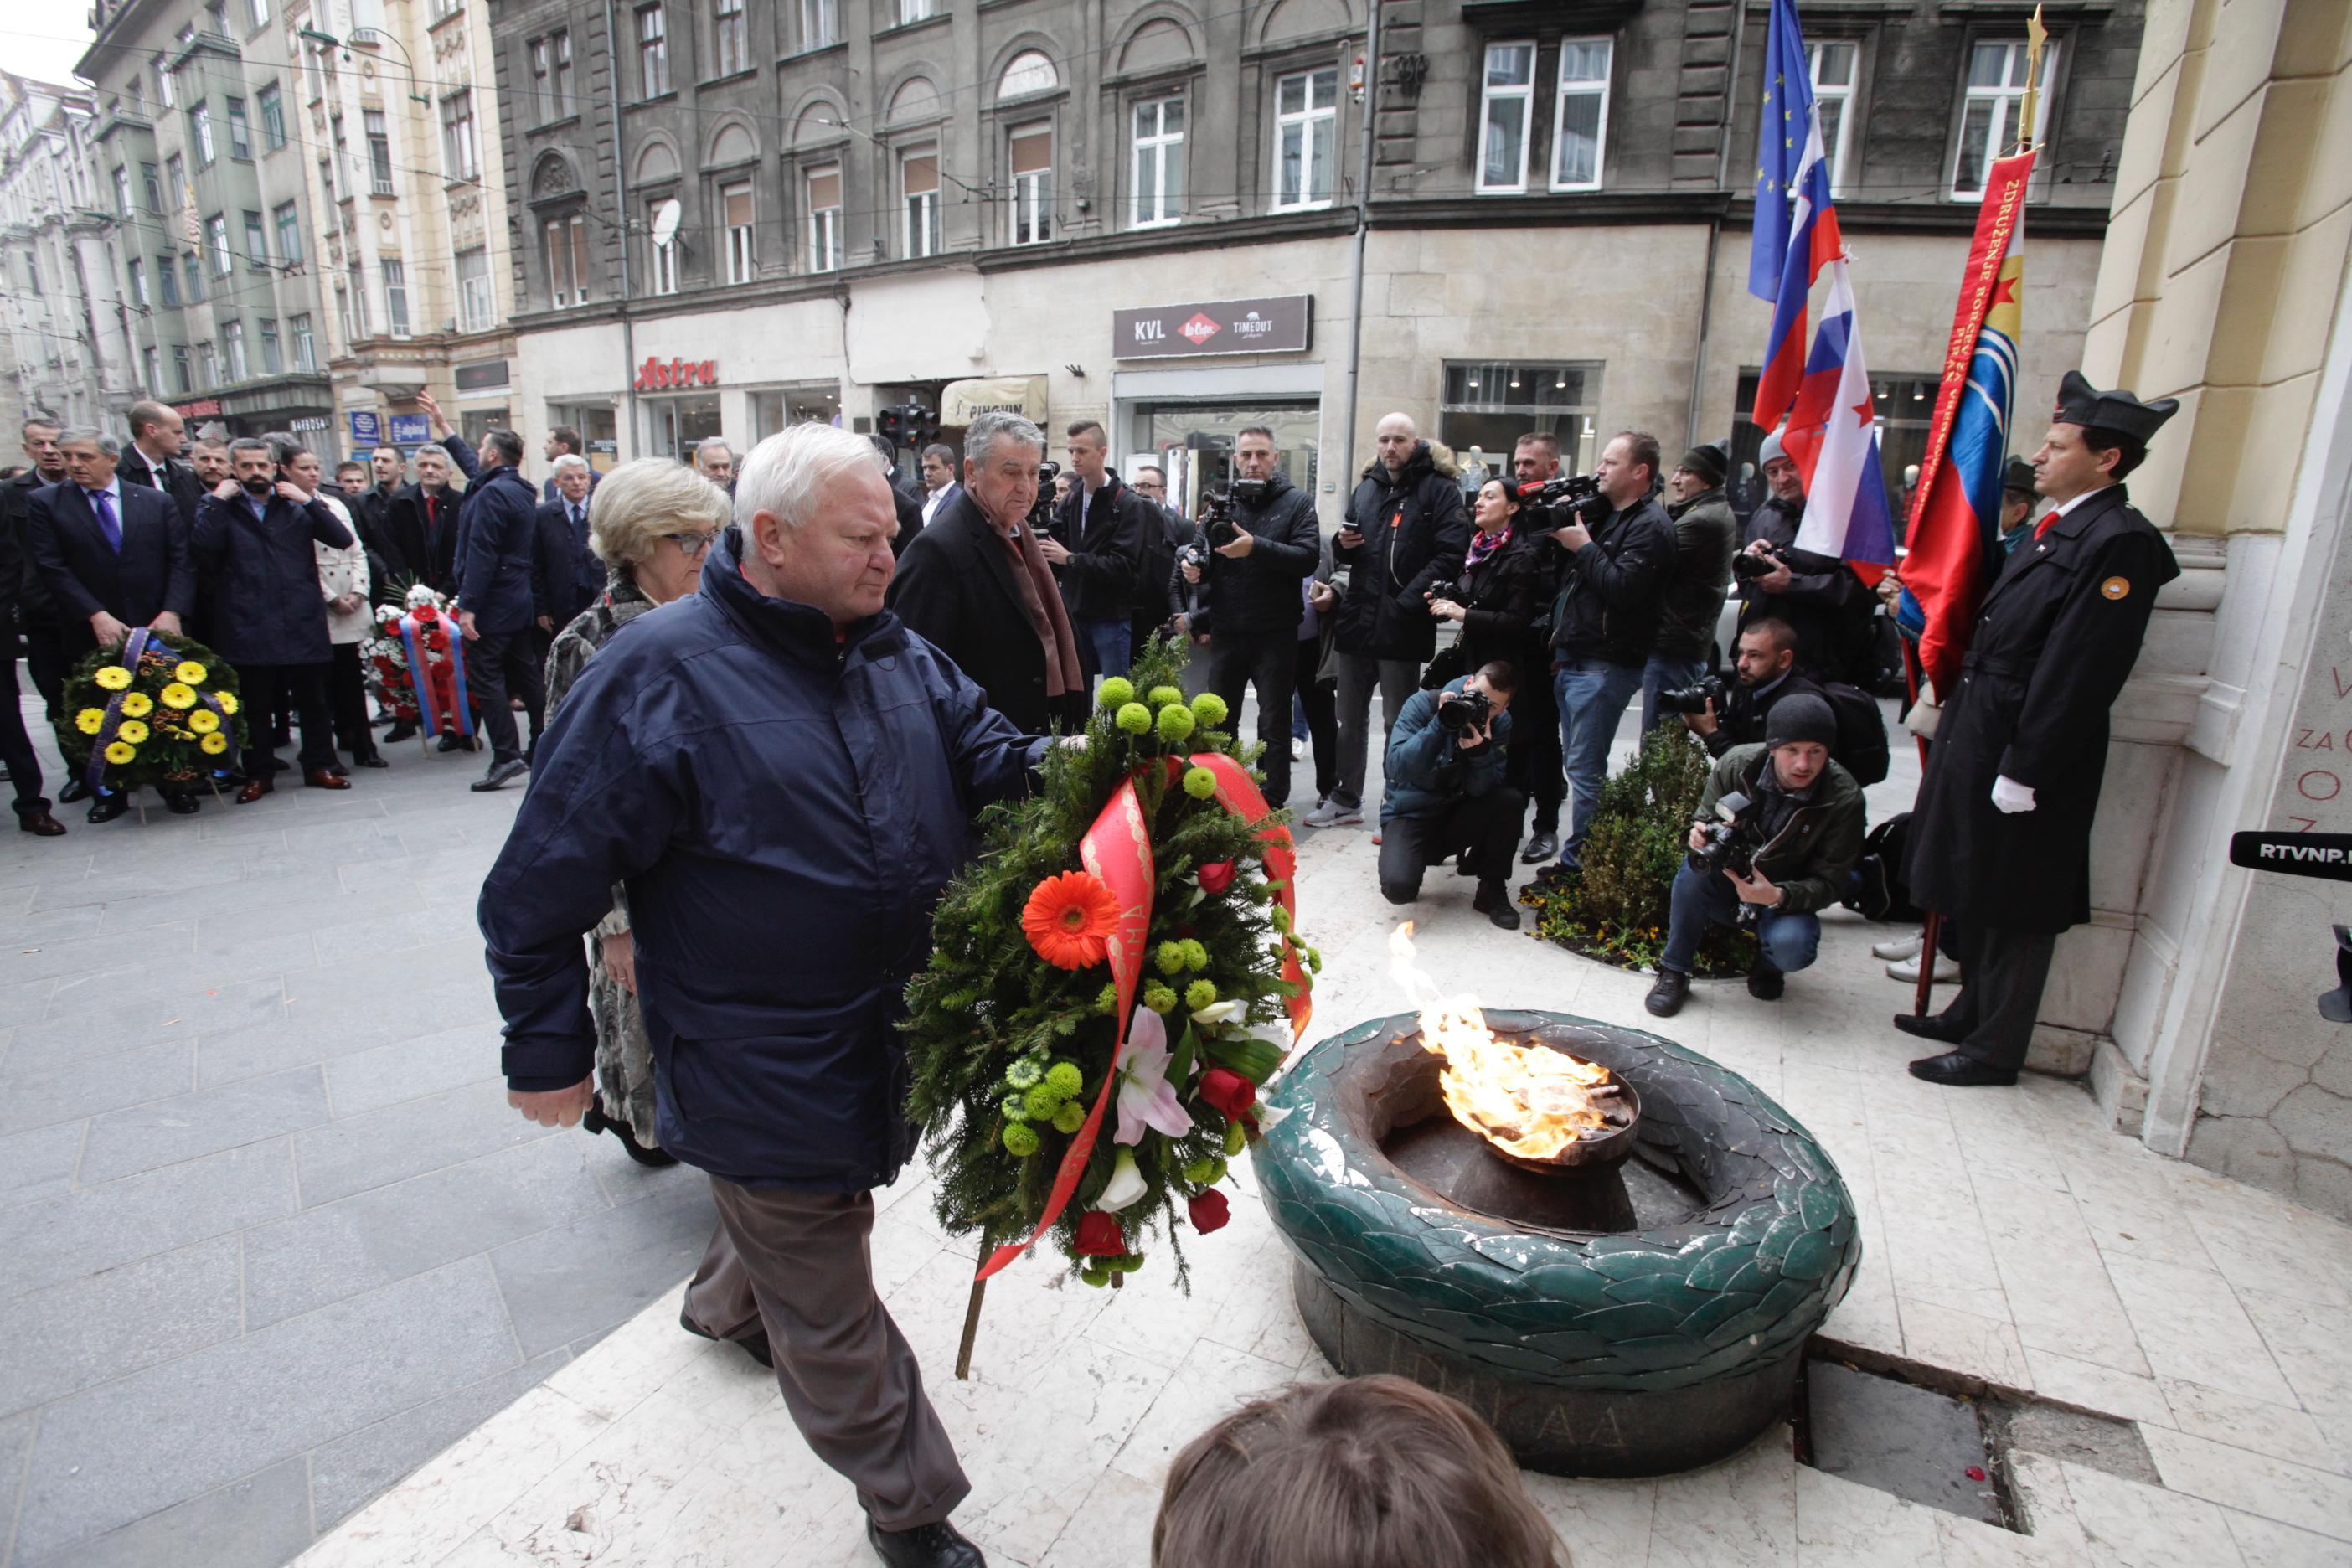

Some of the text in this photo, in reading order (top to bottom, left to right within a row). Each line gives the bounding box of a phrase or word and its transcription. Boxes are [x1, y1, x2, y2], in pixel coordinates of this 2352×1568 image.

[1980, 178, 2020, 281] ZDRUŽENJE
[1135, 320, 1166, 340] KVL
[1233, 321, 1272, 333] TIMEOUT
[1961, 286, 1987, 355] BORCEV
[1944, 327, 1965, 382] PIRAN
[634, 357, 718, 389] Astra
[970, 404, 1023, 419] PINGVIN
[2297, 729, 2334, 751] ZA
